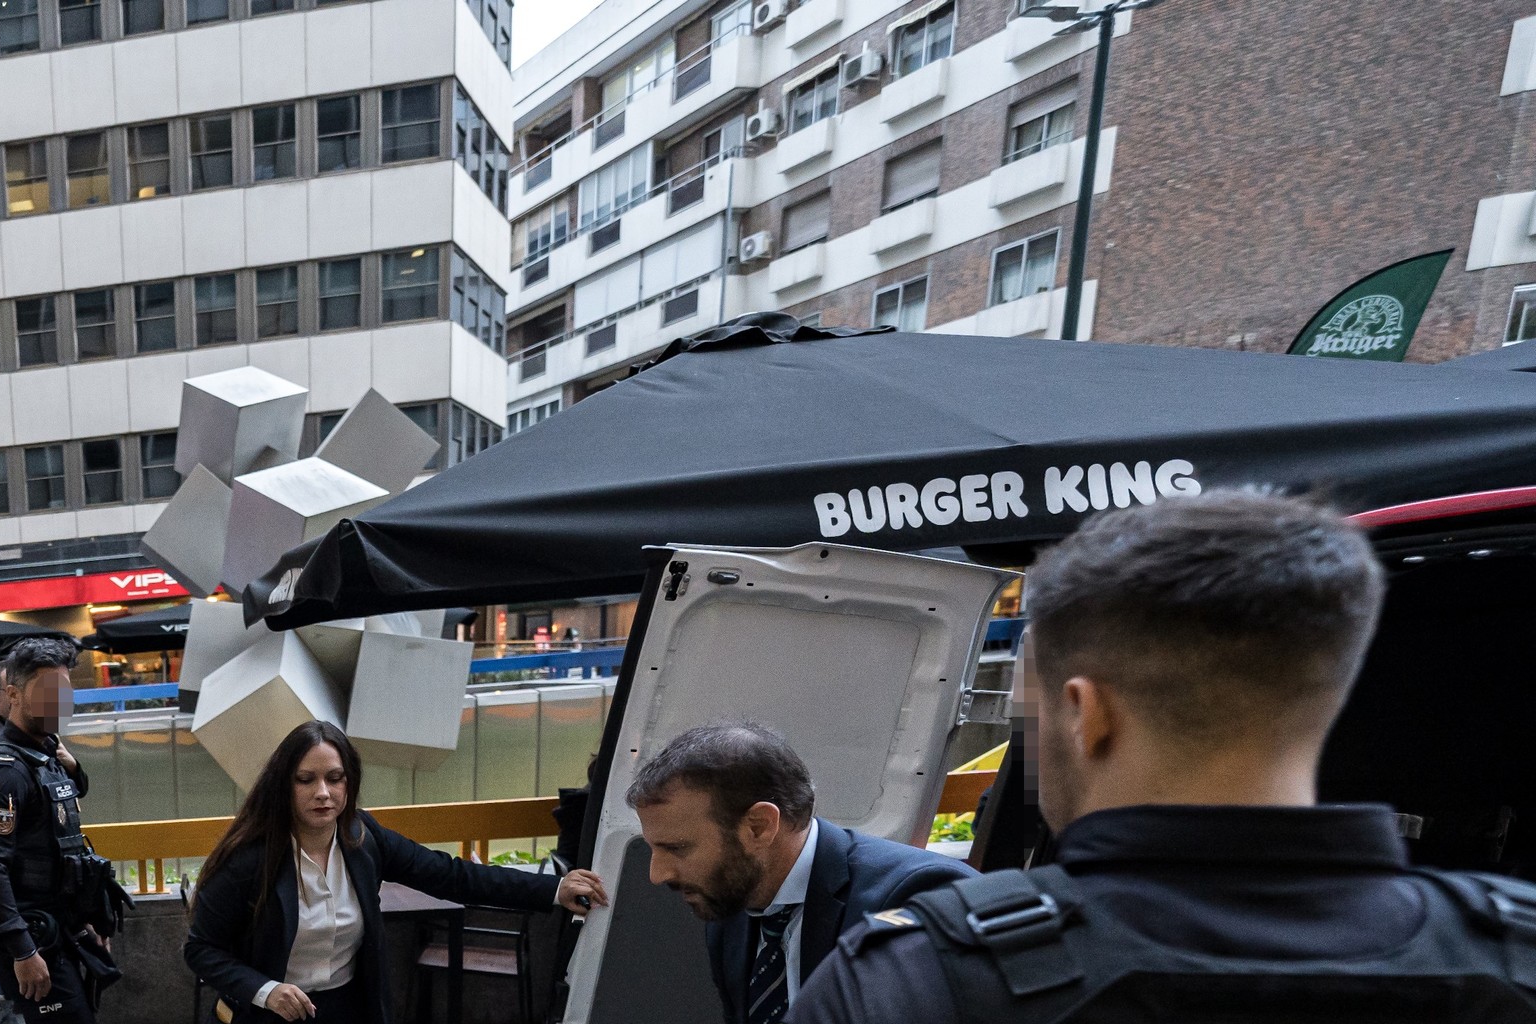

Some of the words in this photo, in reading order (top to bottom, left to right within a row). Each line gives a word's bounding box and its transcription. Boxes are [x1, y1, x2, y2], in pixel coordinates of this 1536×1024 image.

[814, 471, 1029, 538] BURGER
[1044, 458, 1201, 515] KING
[39, 1003, 63, 1013] CNP
